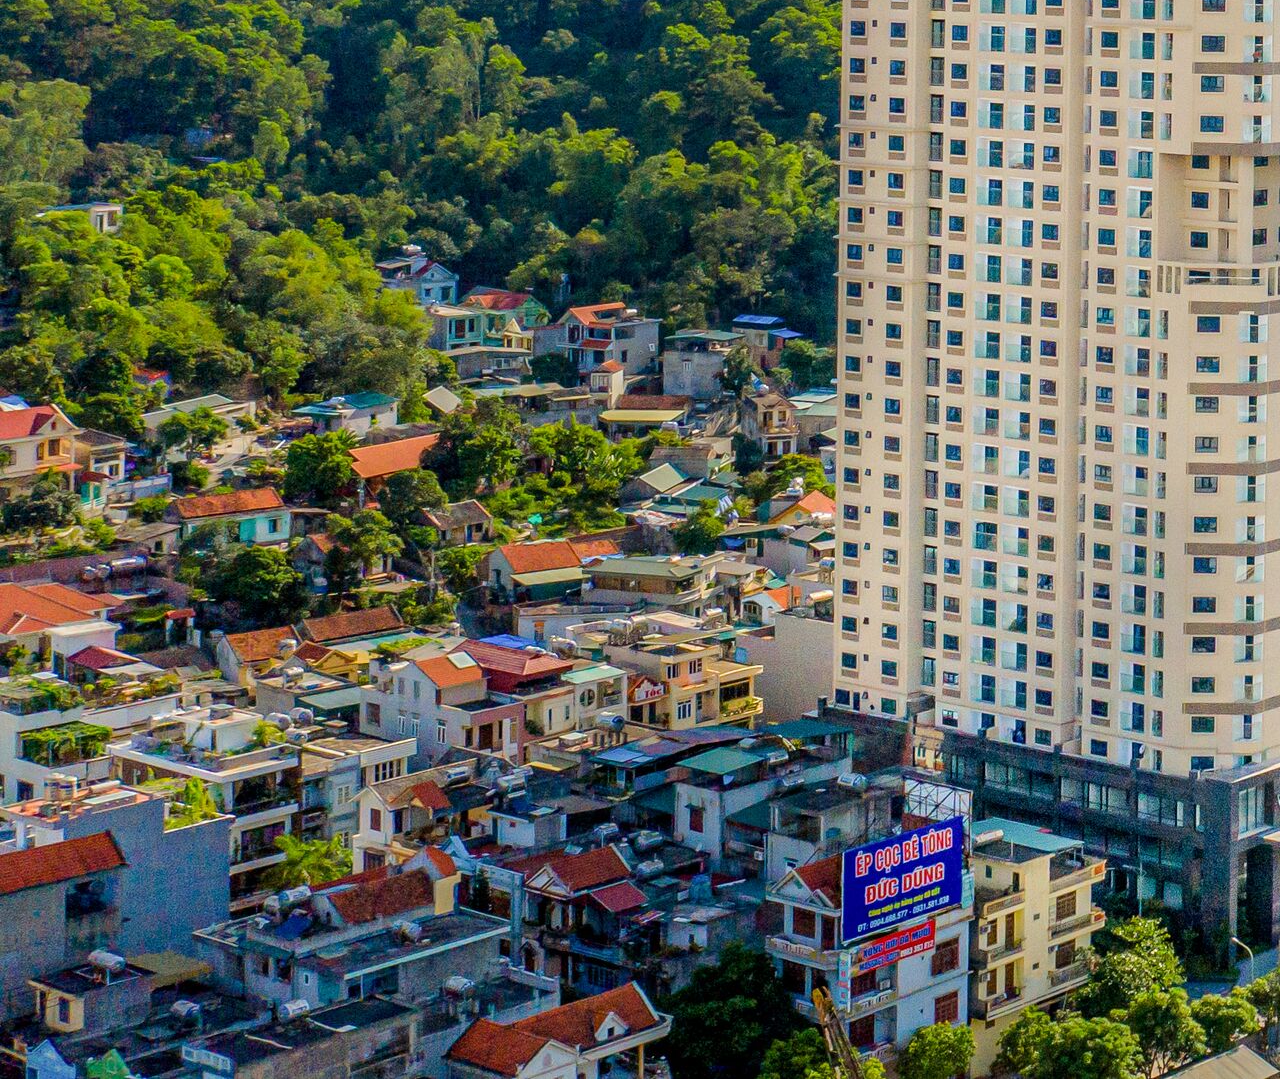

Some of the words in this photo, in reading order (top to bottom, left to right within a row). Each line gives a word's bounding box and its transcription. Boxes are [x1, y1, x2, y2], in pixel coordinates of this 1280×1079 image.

[875, 844, 901, 873] CỌC
[902, 834, 920, 863] BÊ
[921, 827, 953, 857] TÔNG
[864, 877, 899, 905] ĐỨC
[901, 862, 945, 893] DŨNG
